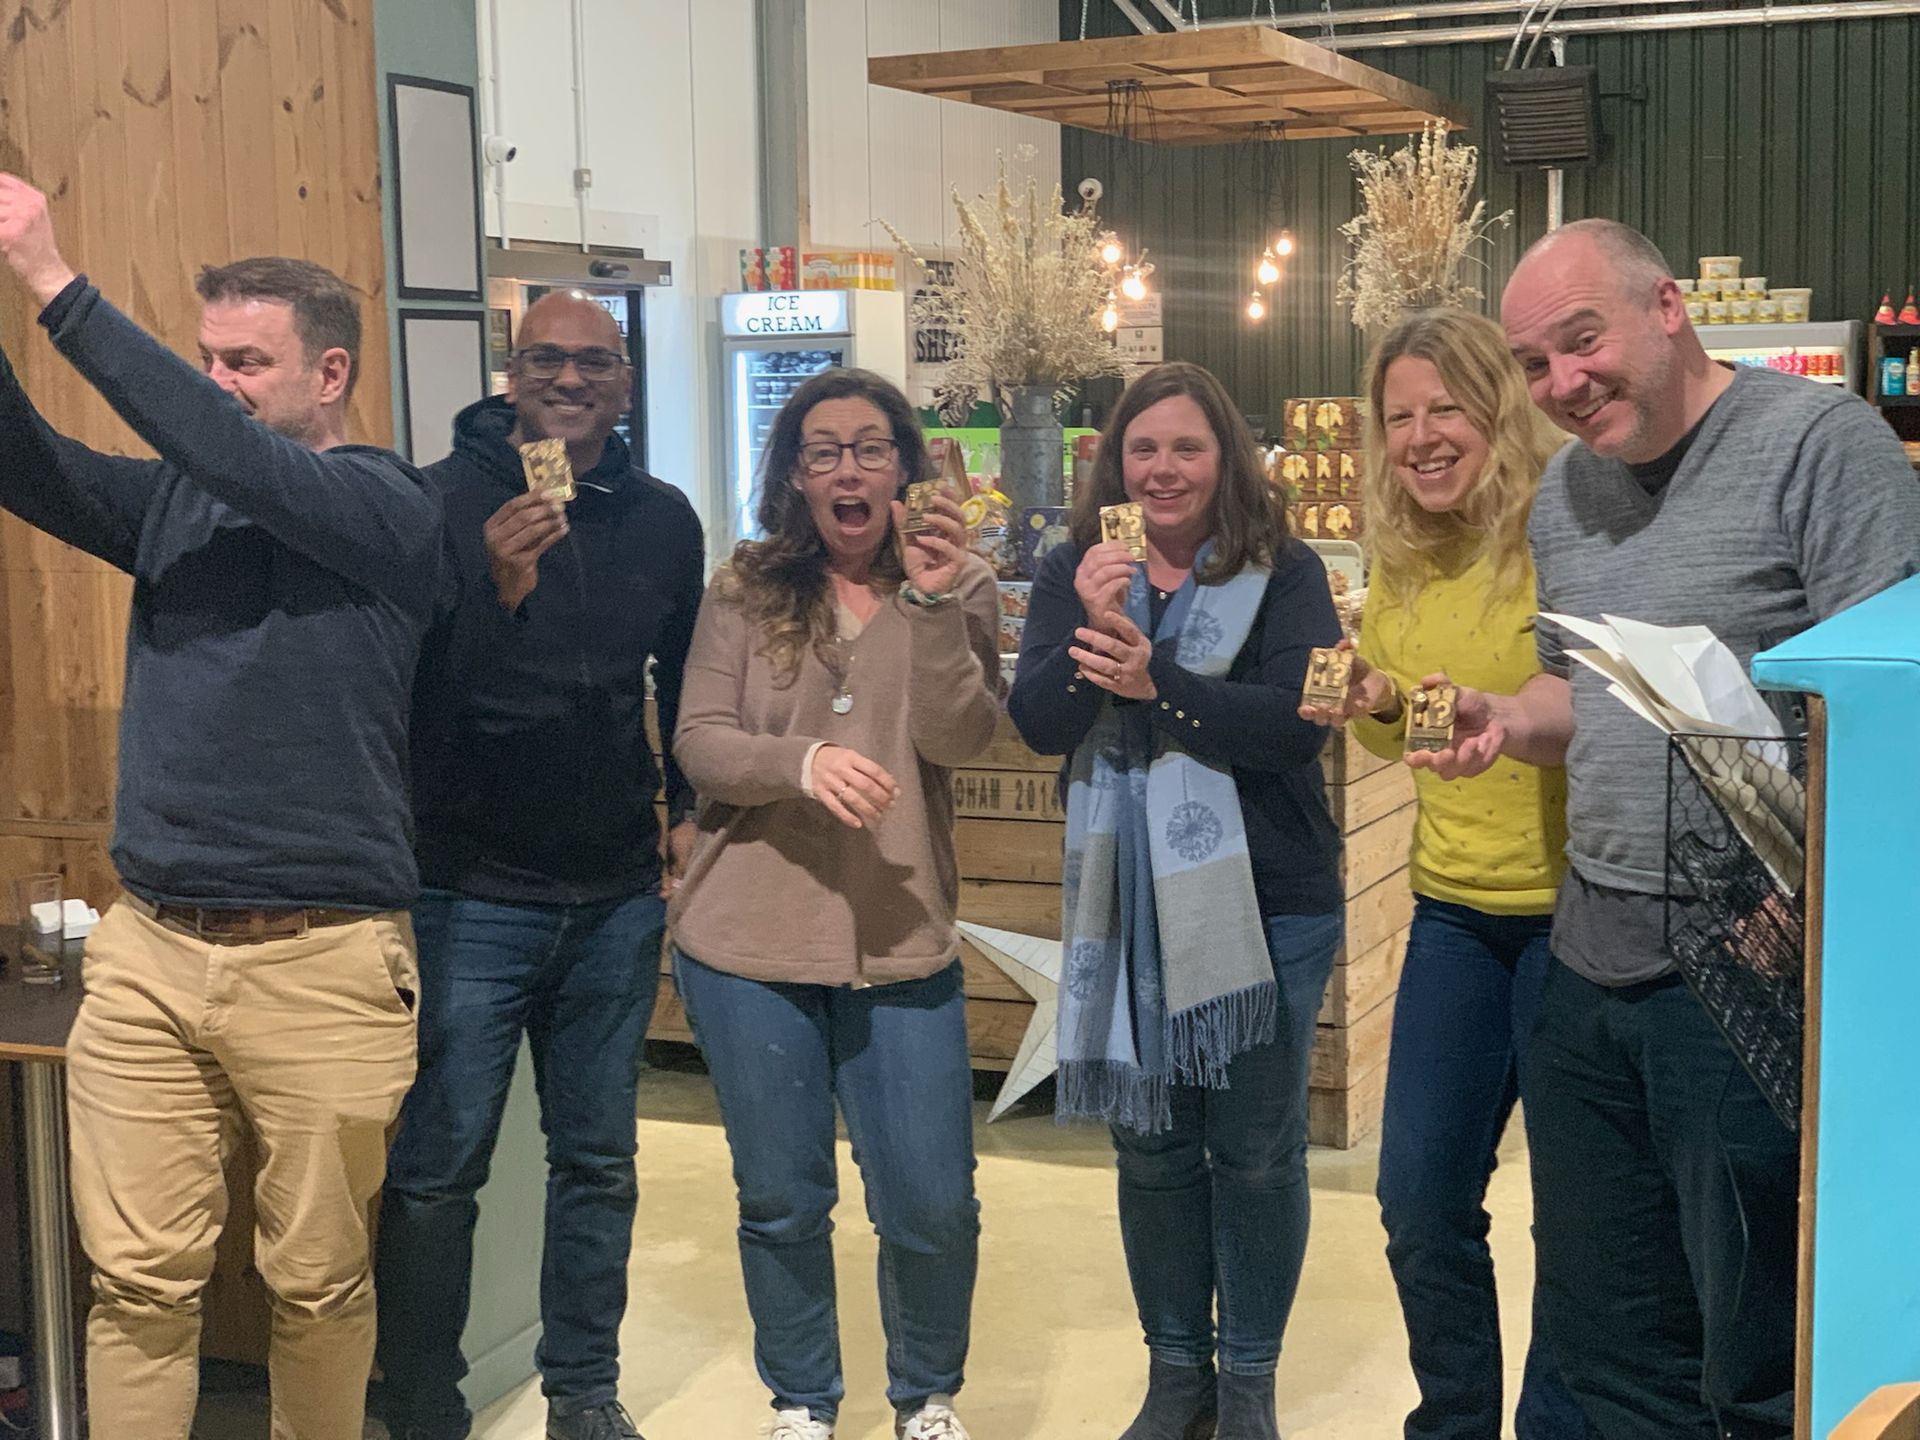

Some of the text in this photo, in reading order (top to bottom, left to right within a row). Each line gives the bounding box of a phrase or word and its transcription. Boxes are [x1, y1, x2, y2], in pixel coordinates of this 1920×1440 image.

[925, 260, 955, 287] THE
[767, 295, 800, 311] ICE
[746, 315, 823, 333] CREAM
